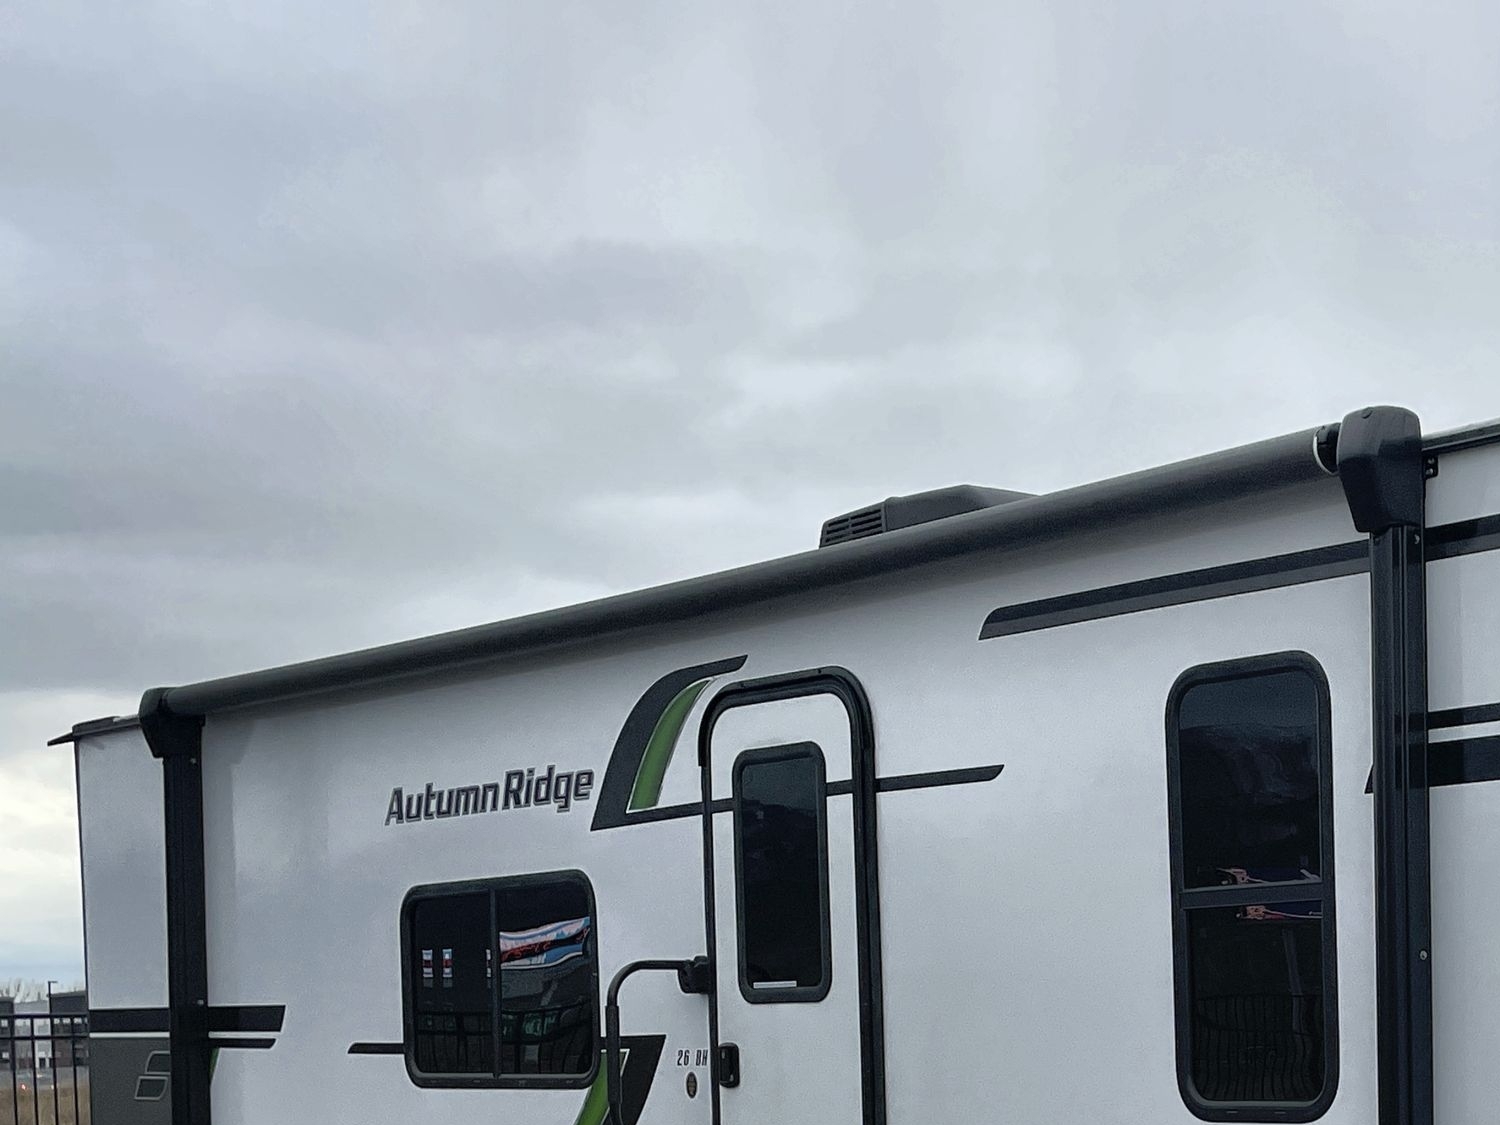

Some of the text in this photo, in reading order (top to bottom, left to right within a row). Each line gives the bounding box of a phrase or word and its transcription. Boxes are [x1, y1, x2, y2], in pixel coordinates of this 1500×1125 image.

[384, 764, 595, 826] Autumn Ridge
[677, 1049, 690, 1066] 26
